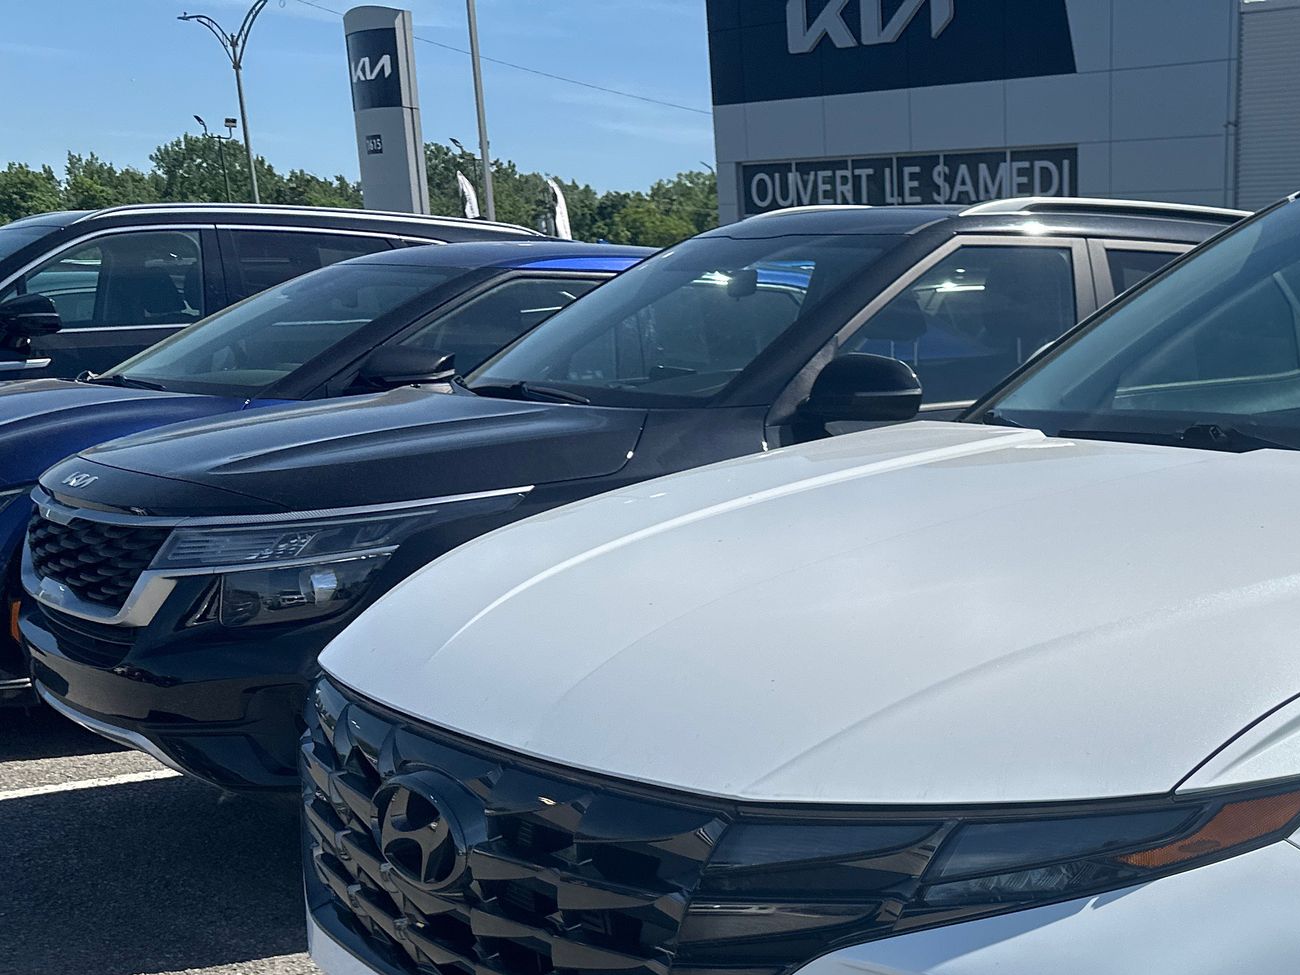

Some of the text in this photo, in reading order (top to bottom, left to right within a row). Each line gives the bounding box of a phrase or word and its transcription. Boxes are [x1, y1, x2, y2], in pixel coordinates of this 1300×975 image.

[352, 54, 392, 83] KIA
[751, 159, 1070, 208] OUVERT LE SAMEDI
